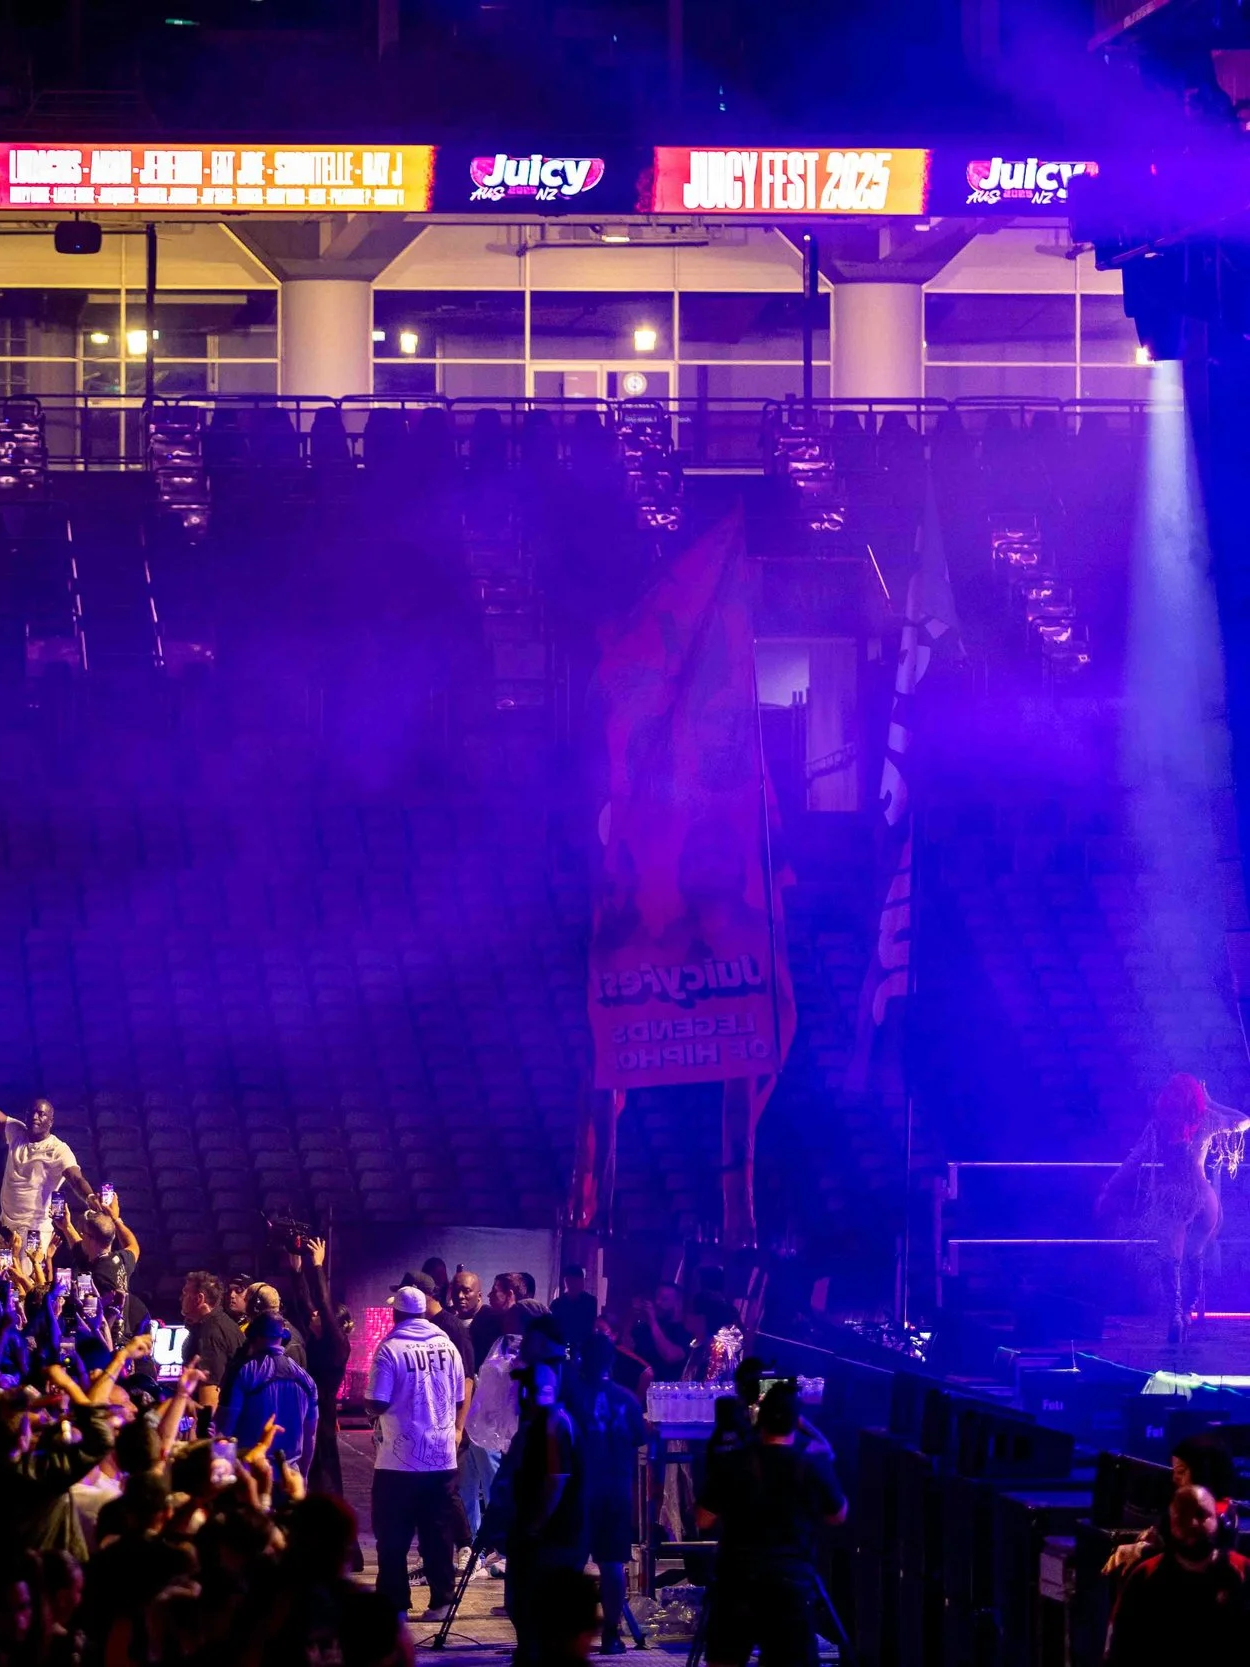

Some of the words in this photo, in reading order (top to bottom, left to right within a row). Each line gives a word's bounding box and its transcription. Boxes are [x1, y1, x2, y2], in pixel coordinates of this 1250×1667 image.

[482, 154, 591, 195] Juicy
[683, 151, 758, 209] JUICY
[762, 151, 819, 209] FEST
[820, 152, 892, 209] 2025
[470, 187, 505, 201] AUS
[535, 188, 558, 201] NZ
[966, 190, 1001, 204] AUS
[1031, 190, 1053, 204] NZ
[402, 1349, 455, 1373] LUFFY
